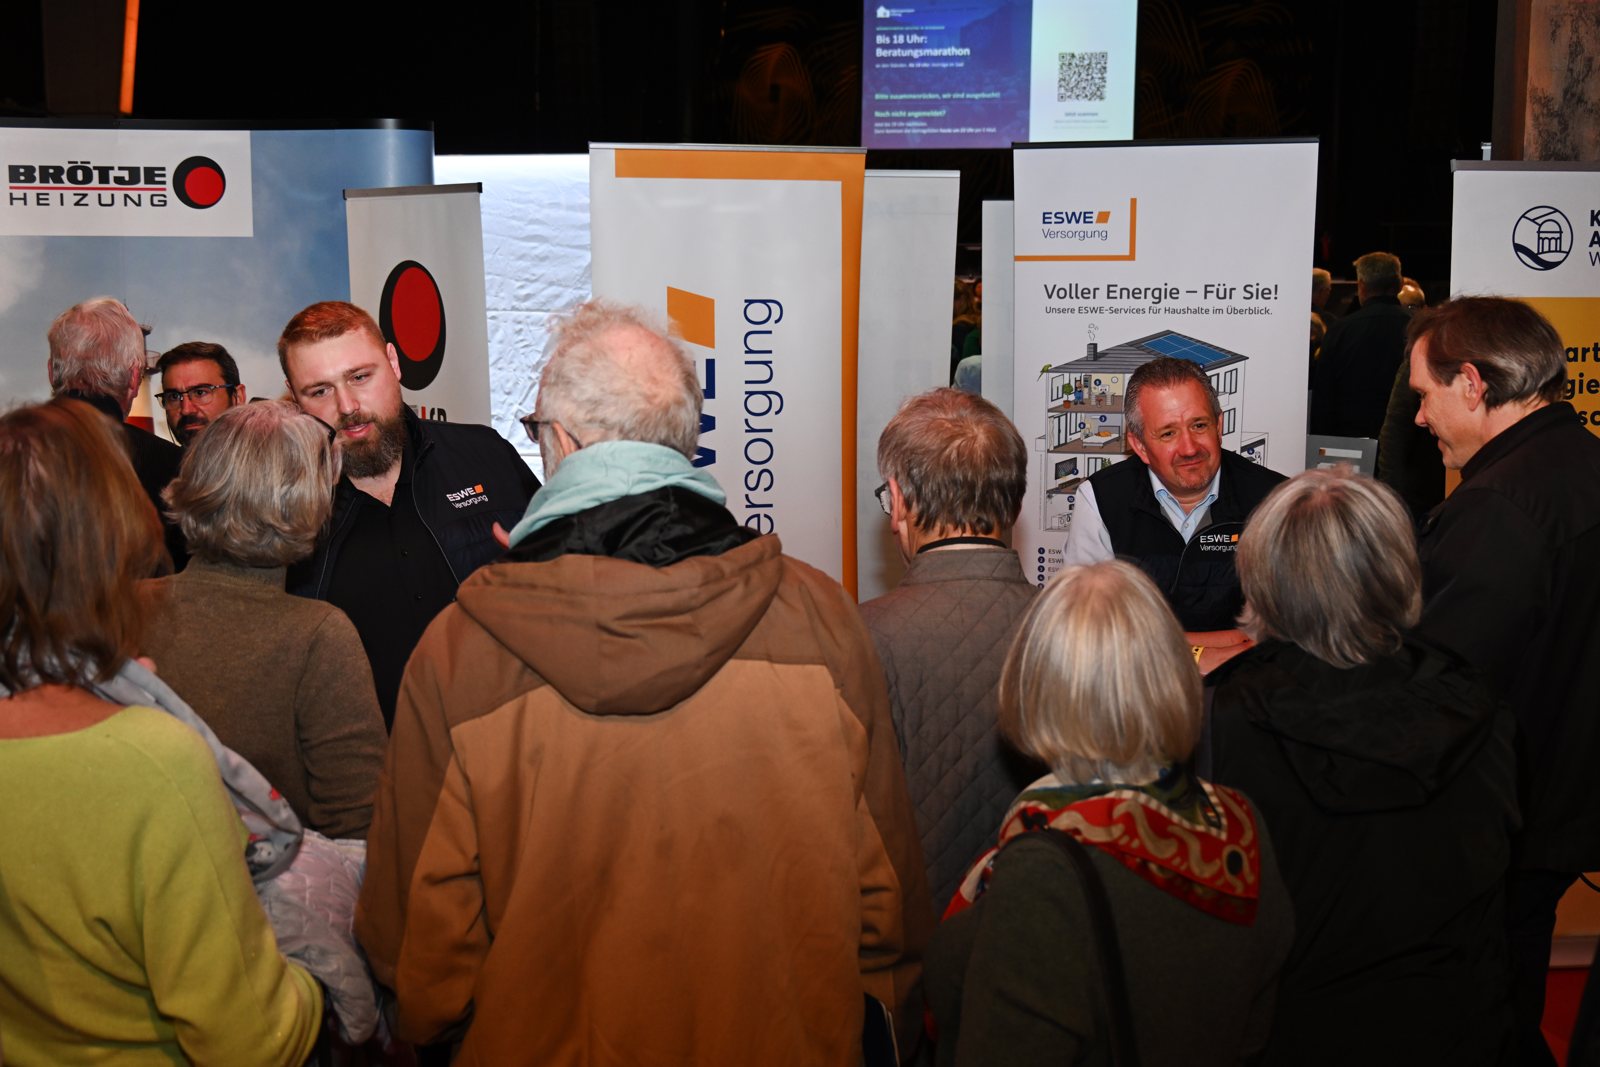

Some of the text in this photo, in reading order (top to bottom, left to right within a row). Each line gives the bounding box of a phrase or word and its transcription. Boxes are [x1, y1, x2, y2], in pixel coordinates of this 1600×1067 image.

[876, 34, 928, 44] Bis 18 Uhr:
[876, 46, 970, 58] Beratungsmarathon
[8, 161, 166, 185] BRÖTJE
[9, 193, 167, 207] HEIZUNG
[1042, 211, 1093, 224] ESWE
[1042, 228, 1108, 241] Versorgung
[1044, 283, 1100, 300] Voller
[1107, 282, 1180, 304] Energie
[1204, 283, 1236, 300] Für
[1243, 282, 1278, 300] Sie!
[1045, 305, 1273, 315] Unsere ESWE-Services für Haushalte im Überblick.
[1565, 342, 1600, 362] art
[1563, 372, 1600, 400] gie
[743, 298, 784, 535] ersorgung
[446, 487, 476, 502] ESWE
[452, 494, 489, 508] Versorgung
[1200, 534, 1230, 543] ESWE
